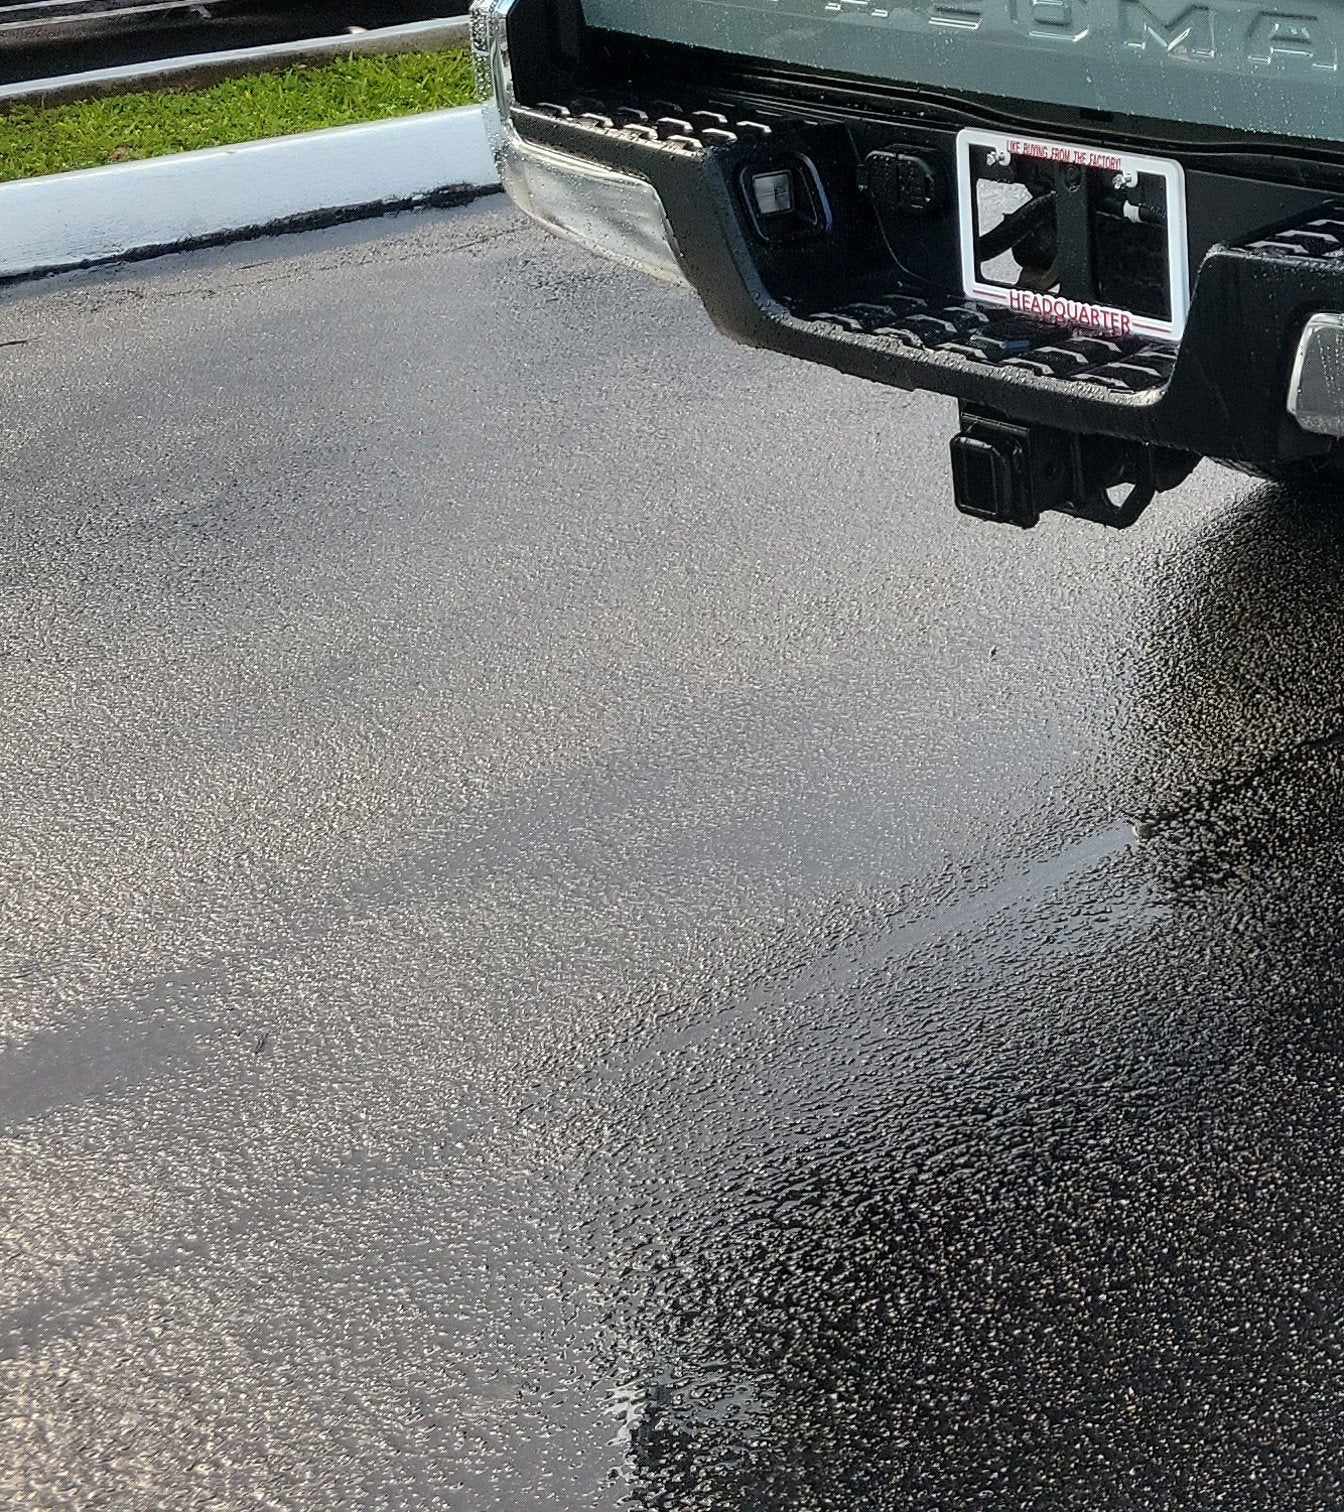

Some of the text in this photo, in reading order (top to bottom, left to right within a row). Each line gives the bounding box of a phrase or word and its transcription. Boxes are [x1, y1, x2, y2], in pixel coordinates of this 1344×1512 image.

[1006, 140, 1021, 154] LIKE
[1024, 142, 1048, 159] BUYING
[1051, 147, 1071, 163] FROM
[1074, 151, 1087, 165] THE
[1009, 290, 1131, 333] HEADQUARTER
